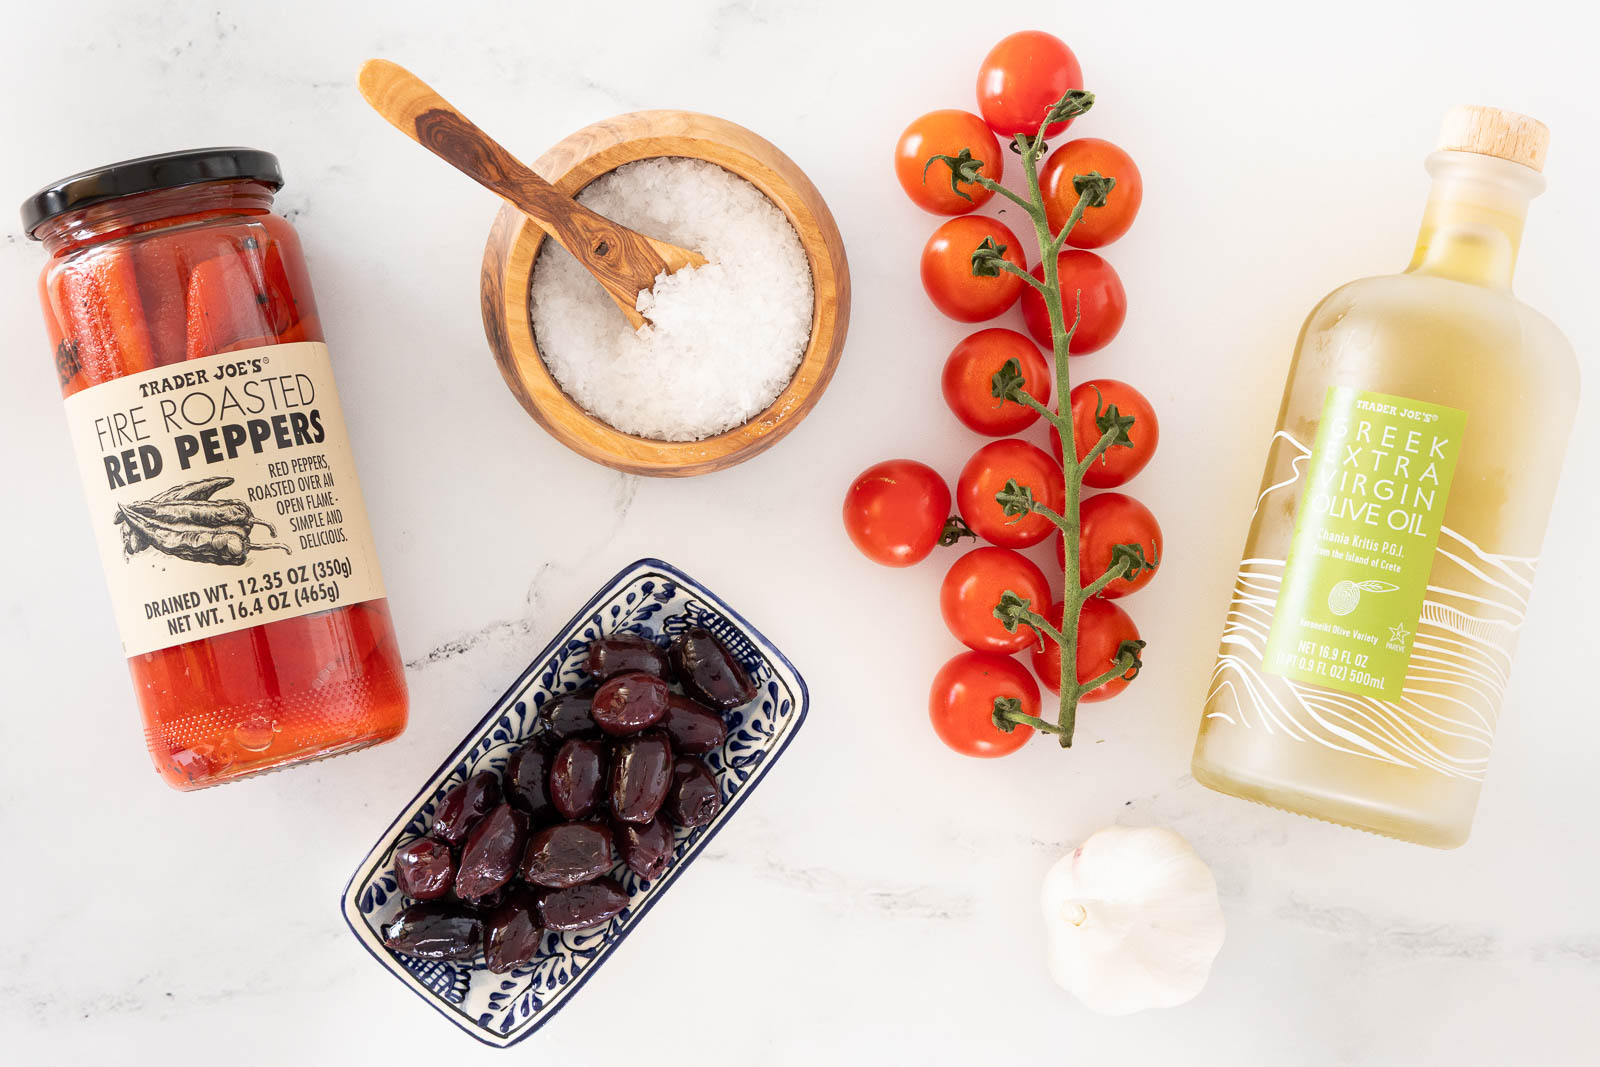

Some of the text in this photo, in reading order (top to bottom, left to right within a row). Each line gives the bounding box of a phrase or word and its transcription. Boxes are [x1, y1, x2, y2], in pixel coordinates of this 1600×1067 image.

[139, 368, 210, 397] TRADER
[94, 373, 315, 452] FIRE ROASTED
[1356, 399, 1397, 416] TRADER
[103, 409, 325, 490] RED PEPPERS
[1331, 416, 1448, 460] GREEK
[268, 454, 330, 478] RED PEPPERS,
[1325, 440, 1439, 486] EXTRA
[247, 472, 335, 502] ROASTED OVER AN
[1320, 468, 1436, 511] VIRGIN
[276, 496, 305, 515] OPEN
[1311, 493, 1427, 537] OLIVE OIL
[290, 509, 343, 532] SIMPLE AND
[299, 527, 348, 550] DELICIOUS.
[1352, 535, 1379, 552] Kritis
[1332, 549, 1344, 560] the
[1345, 551, 1370, 565] Island
[1371, 558, 1380, 568] of
[1380, 559, 1401, 573] Crete
[144, 556, 352, 620] DRAINED WT. 12.35 OZ (350g)
[167, 581, 340, 636] NET WT. 16.4 OZ (465g)
[1332, 624, 1351, 638] Olive
[1352, 629, 1379, 646] Variety
[1298, 640, 1369, 668] NET 16.9 FL OZ
[1298, 656, 1315, 672] 0.9
[1316, 661, 1327, 676] FL
[1329, 664, 1348, 681] OZ)
[1349, 669, 1385, 690] 500mL
